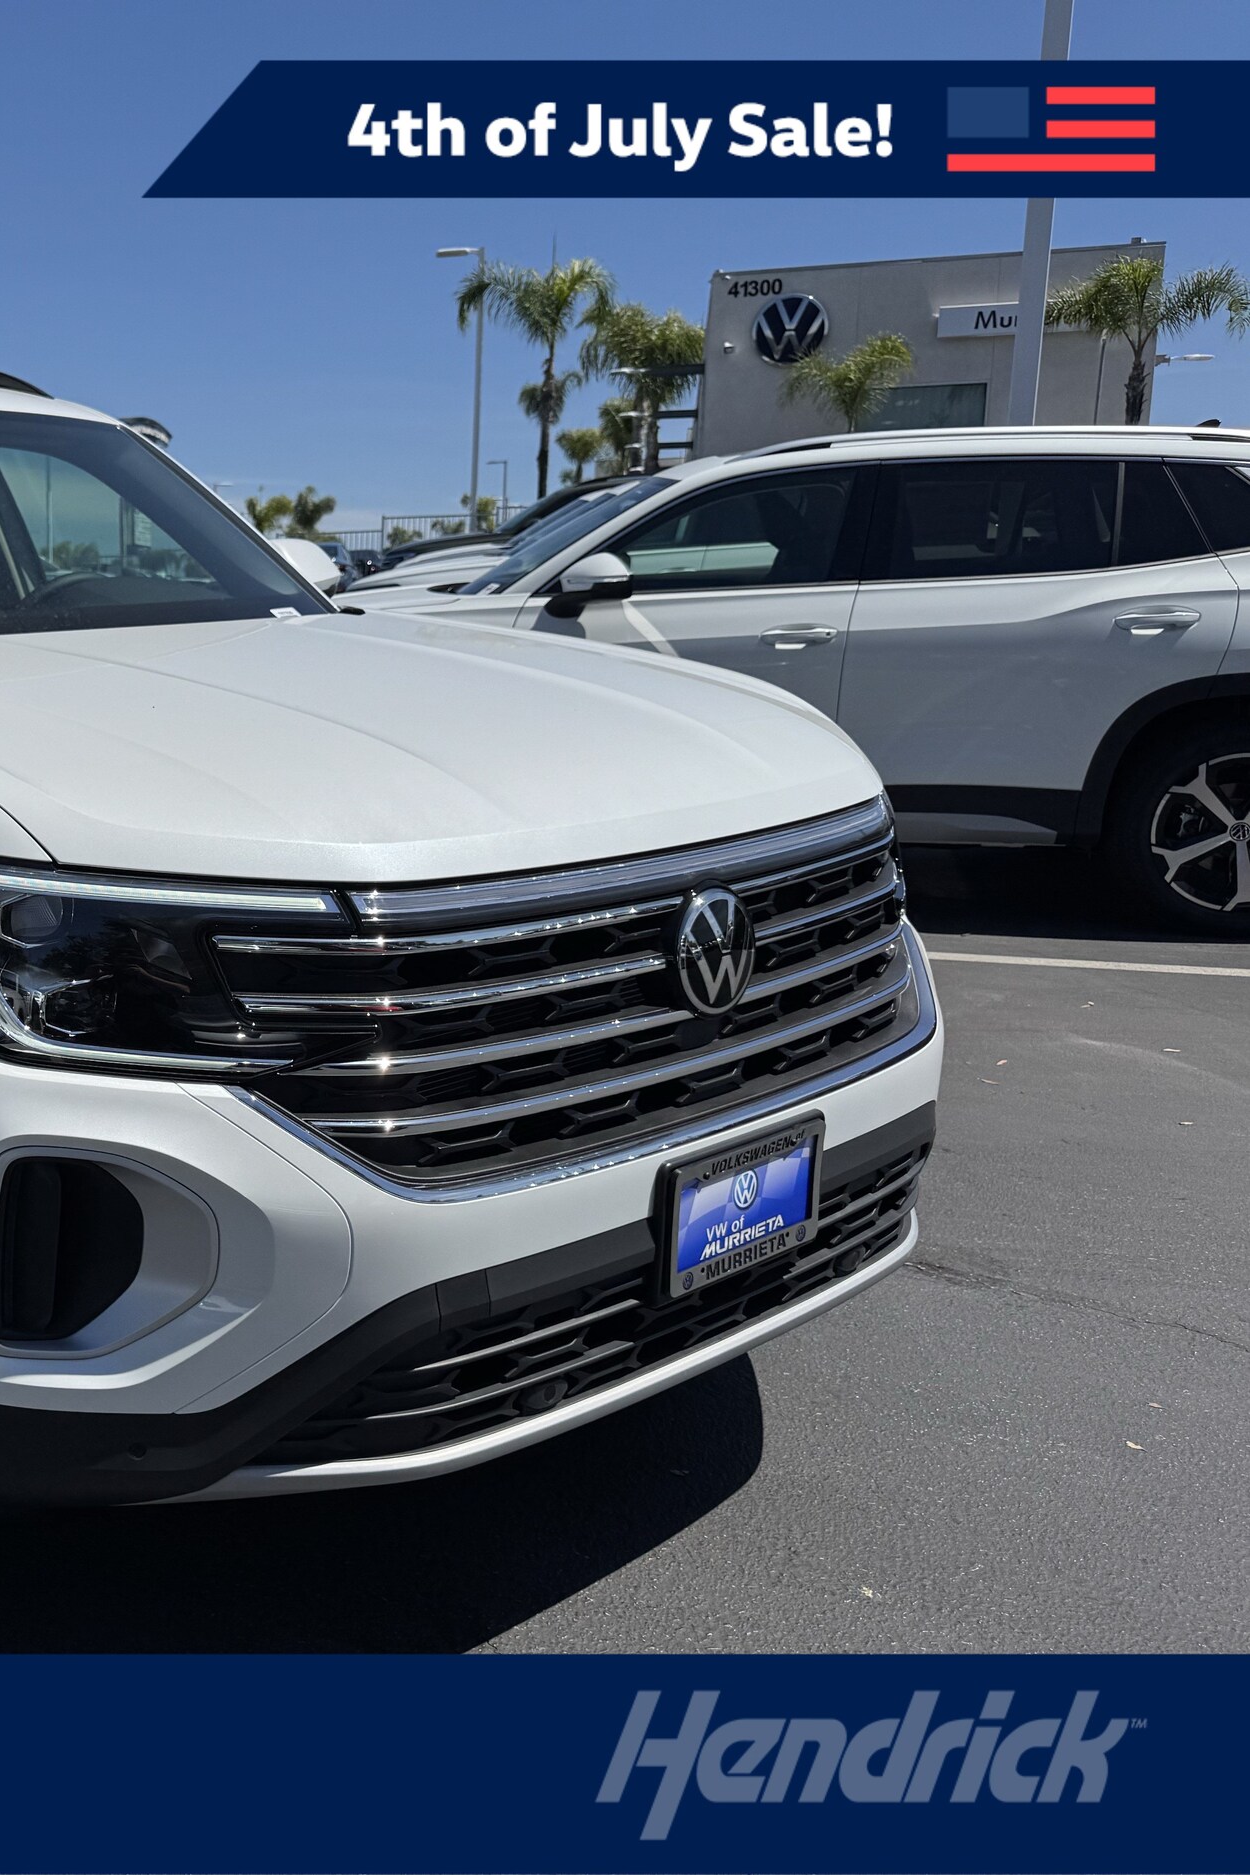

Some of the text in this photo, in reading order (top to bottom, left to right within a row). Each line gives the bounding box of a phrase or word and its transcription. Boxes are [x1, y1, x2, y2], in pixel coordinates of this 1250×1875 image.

[728, 278, 783, 298] 41300
[711, 1135, 792, 1176] VOLKSWAGEN
[700, 1214, 784, 1260] MURRIETA
[706, 1215, 745, 1241] VW of
[705, 1235, 787, 1280] MURRIETA
